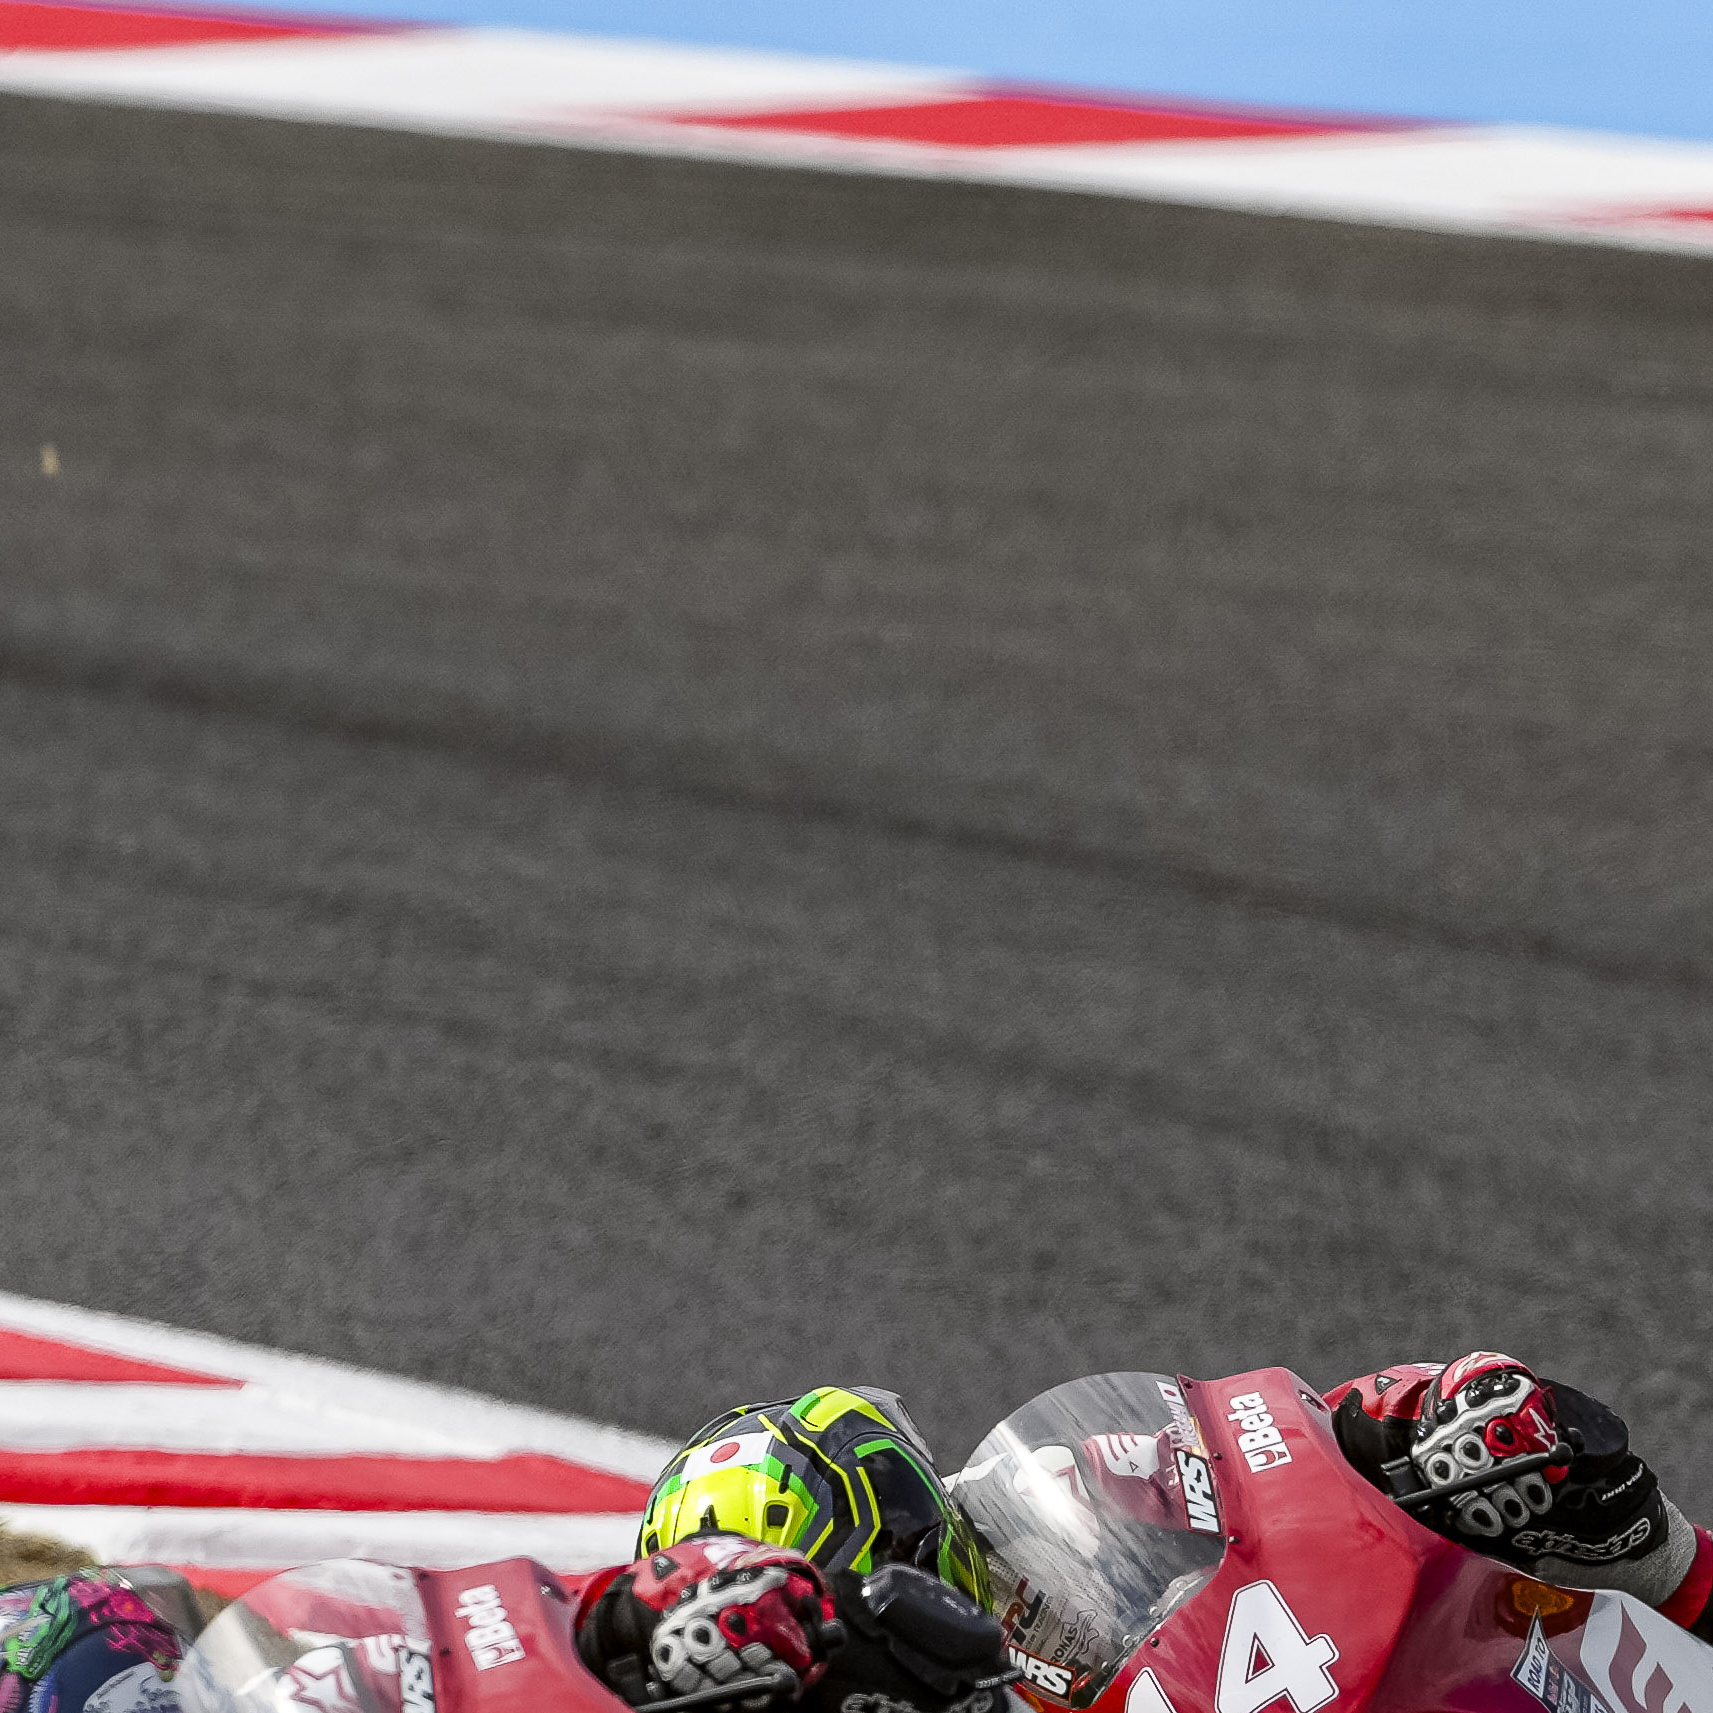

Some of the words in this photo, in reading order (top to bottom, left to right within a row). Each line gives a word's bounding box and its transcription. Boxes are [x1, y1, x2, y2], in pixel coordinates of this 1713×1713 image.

[1228, 1392, 1284, 1452] Beta
[1176, 1450, 1221, 1533] WRS
[454, 1583, 516, 1651] Beta
[1007, 1646, 1073, 1696] WRS
[1527, 1655, 1542, 1693] ROAD
[1536, 1636, 1547, 1660] TO
